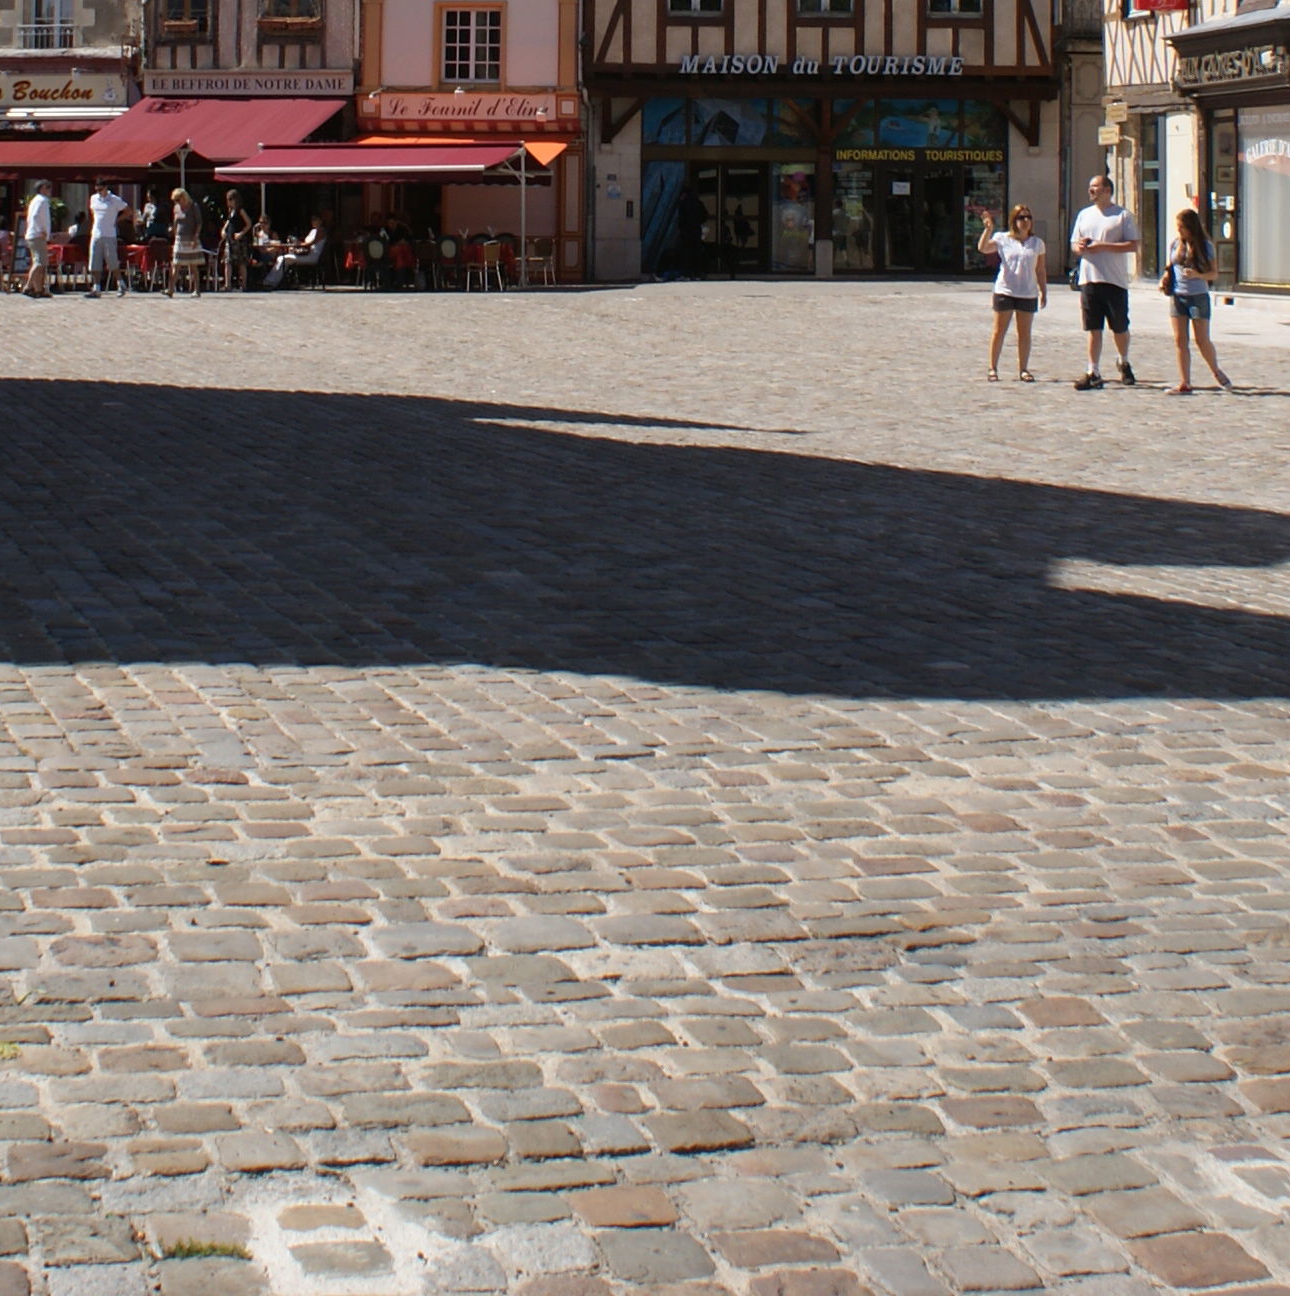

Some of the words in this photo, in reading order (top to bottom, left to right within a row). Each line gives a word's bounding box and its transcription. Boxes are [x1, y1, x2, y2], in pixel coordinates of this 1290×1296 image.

[679, 55, 779, 74] MAISON
[792, 55, 819, 74] du
[830, 55, 965, 75] TOURISME
[12, 80, 94, 101] Bouchon
[152, 78, 169, 90] LE
[172, 78, 229, 90] BEFFROI
[233, 78, 254, 90] DE
[254, 78, 302, 90] NOTRE
[306, 78, 346, 90] DAME
[387, 97, 408, 117] Le
[418, 97, 482, 117] Fournil
[836, 149, 916, 161] INFORMATIONS
[925, 150, 1004, 161] TOURISTIQUES
